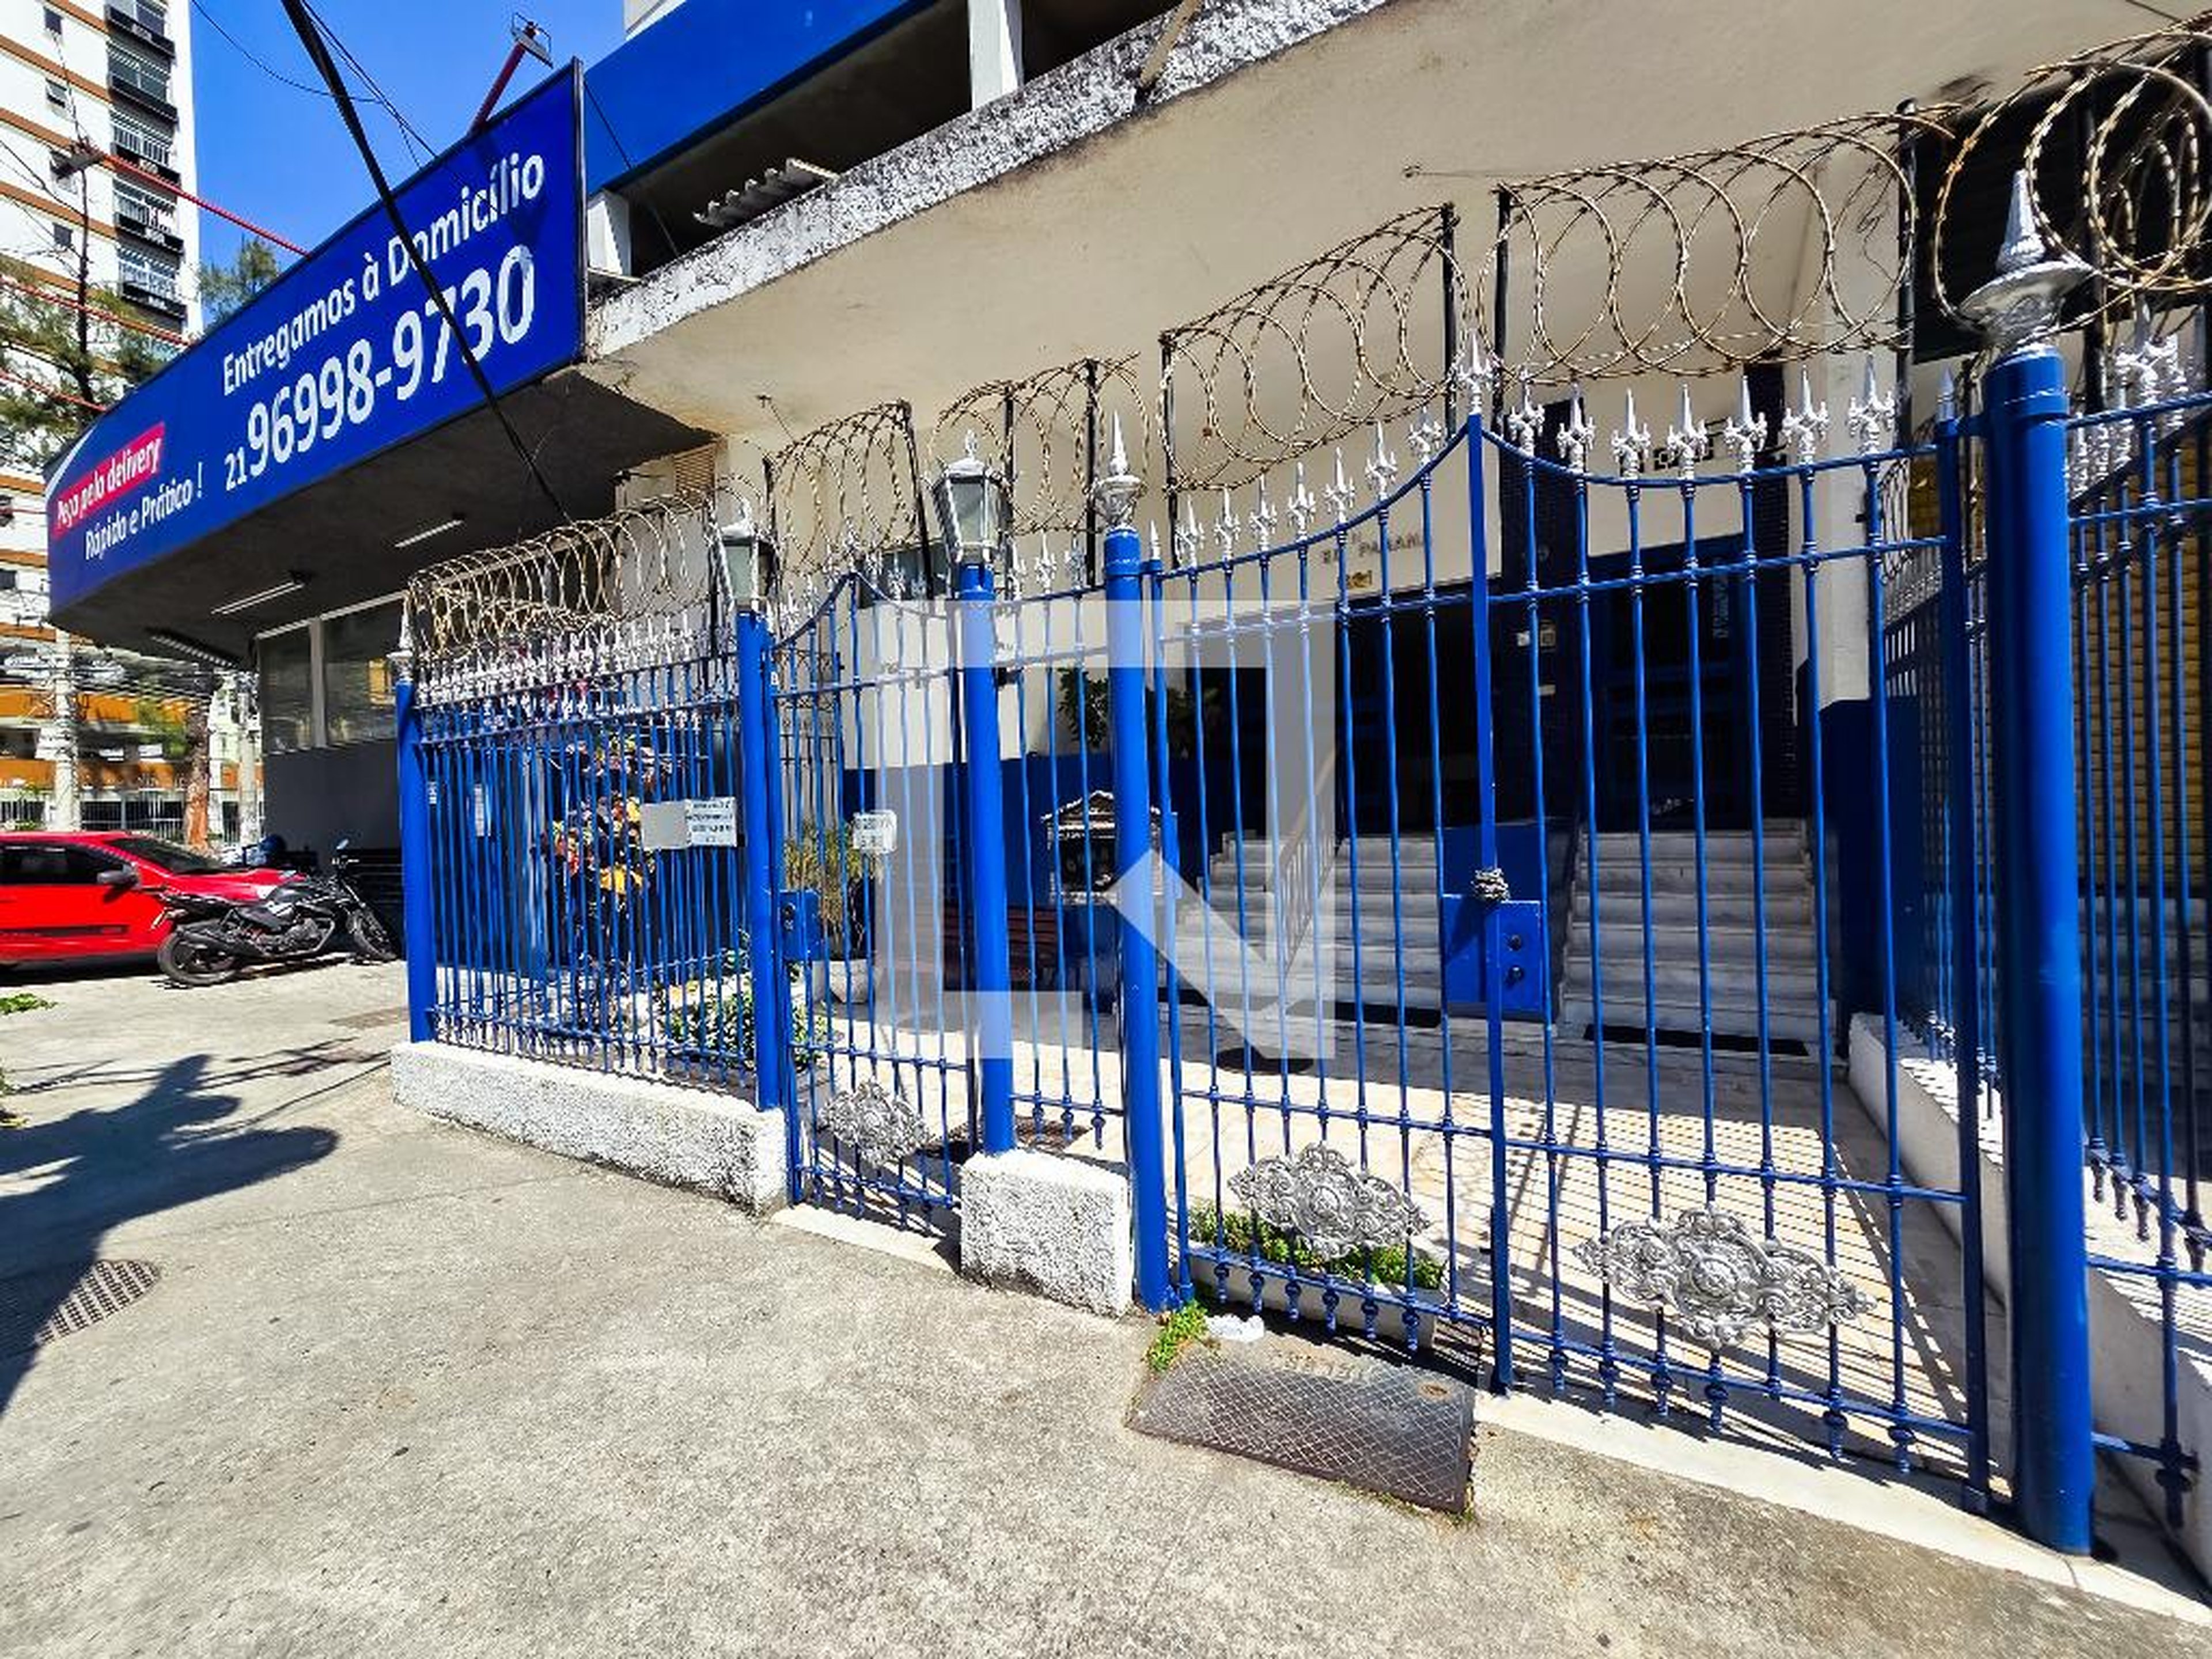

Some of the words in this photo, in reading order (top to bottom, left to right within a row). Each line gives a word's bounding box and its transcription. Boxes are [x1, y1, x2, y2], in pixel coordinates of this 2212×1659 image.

[224, 278, 355, 396] Entregamos
[362, 252, 380, 301] à
[388, 152, 544, 285] Domicílio
[224, 446, 247, 491] 21
[248, 244, 535, 478] 96998-9730
[86, 512, 127, 560] Rápido
[130, 509, 139, 535] e
[142, 478, 193, 529] Prático
[107, 438, 162, 491] delivery
